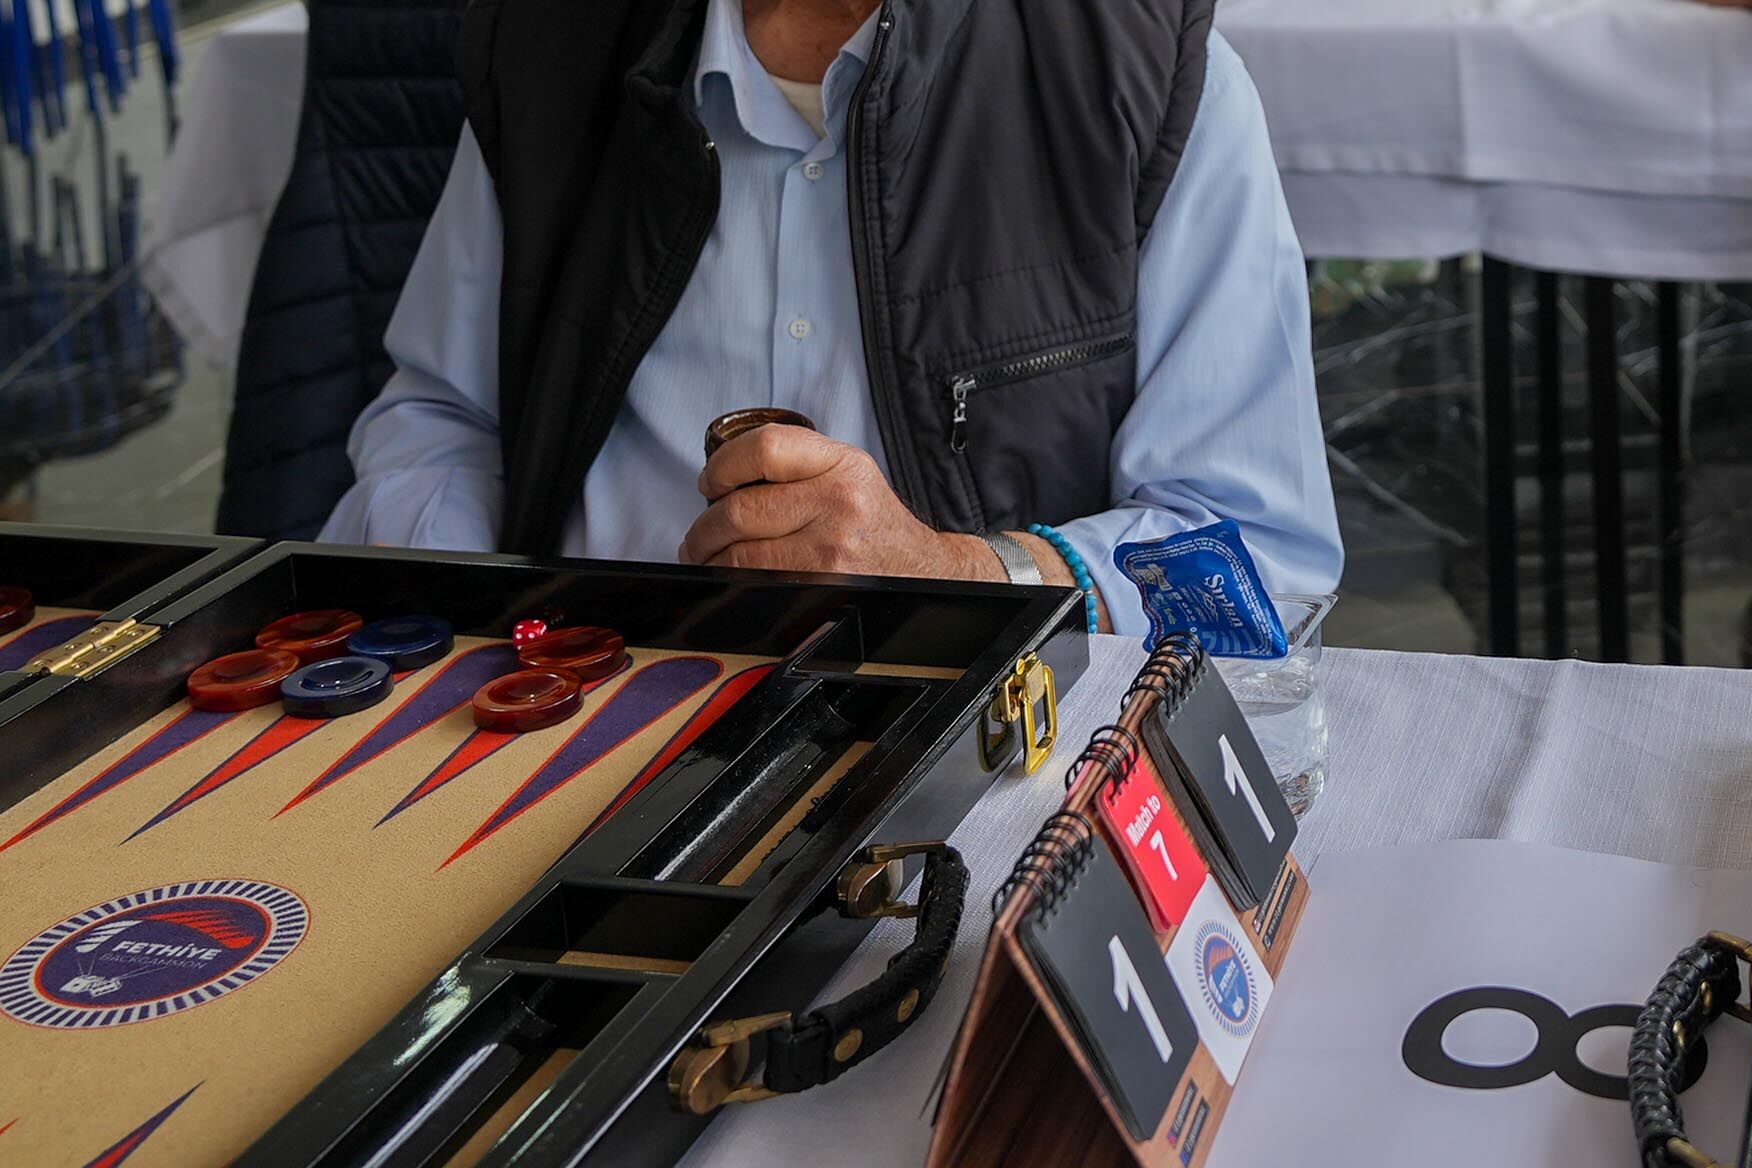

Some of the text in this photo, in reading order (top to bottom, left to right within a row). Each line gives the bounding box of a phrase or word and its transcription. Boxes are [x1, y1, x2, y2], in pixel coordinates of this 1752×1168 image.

[1217, 734, 1276, 843] 1
[1125, 794, 1161, 847] Match to
[1149, 828, 1179, 881] 7
[111, 939, 223, 961] FETHİYE
[1107, 934, 1174, 1064] 1
